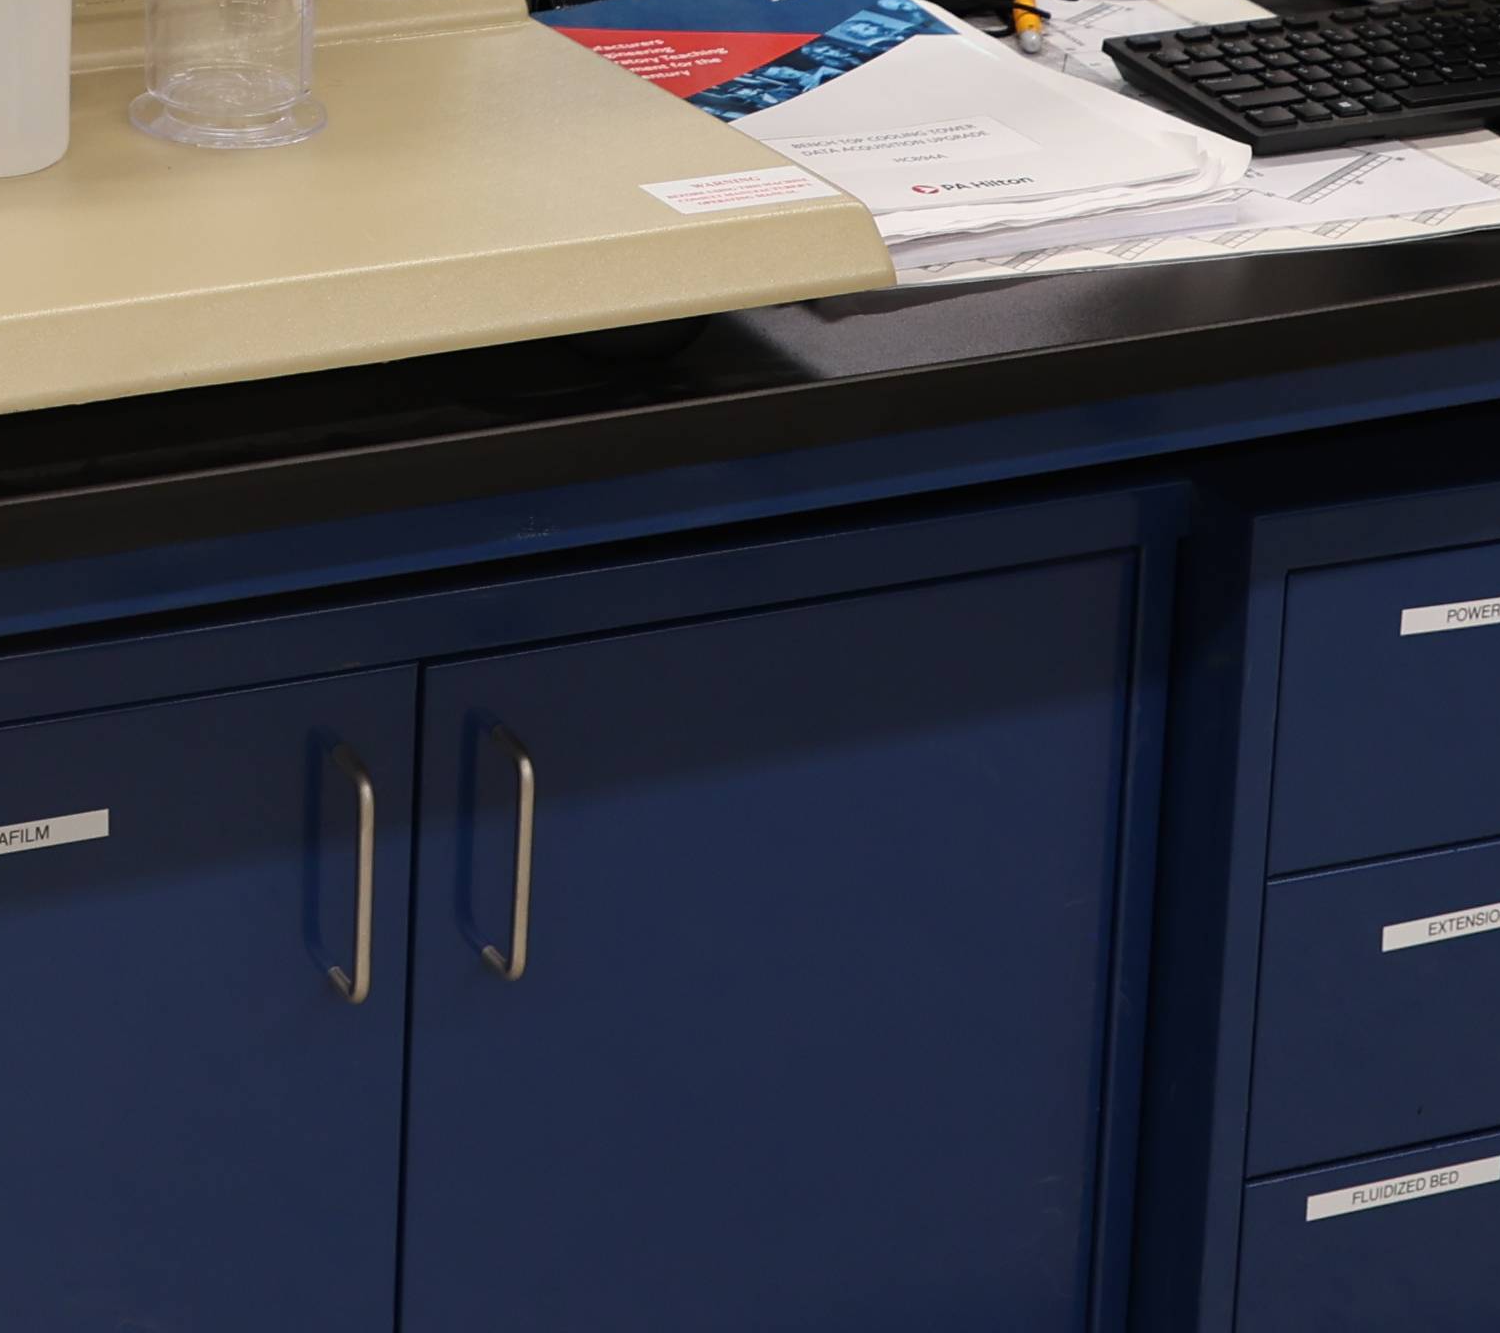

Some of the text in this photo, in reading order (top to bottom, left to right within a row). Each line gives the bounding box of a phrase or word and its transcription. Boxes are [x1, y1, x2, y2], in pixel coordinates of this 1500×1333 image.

[660, 47, 729, 61] Teaching
[670, 61, 693, 69] for
[695, 57, 723, 66] the
[791, 122, 977, 150] BENCH TOP COOLING TOWER
[800, 146, 840, 158] DATA
[925, 129, 991, 144] UPGRADE
[691, 175, 761, 189] WARNING
[941, 174, 1035, 192] PA Hilton
[1445, 602, 1500, 623] POWER
[1351, 1169, 1460, 1206] FLUIDIZED BED
